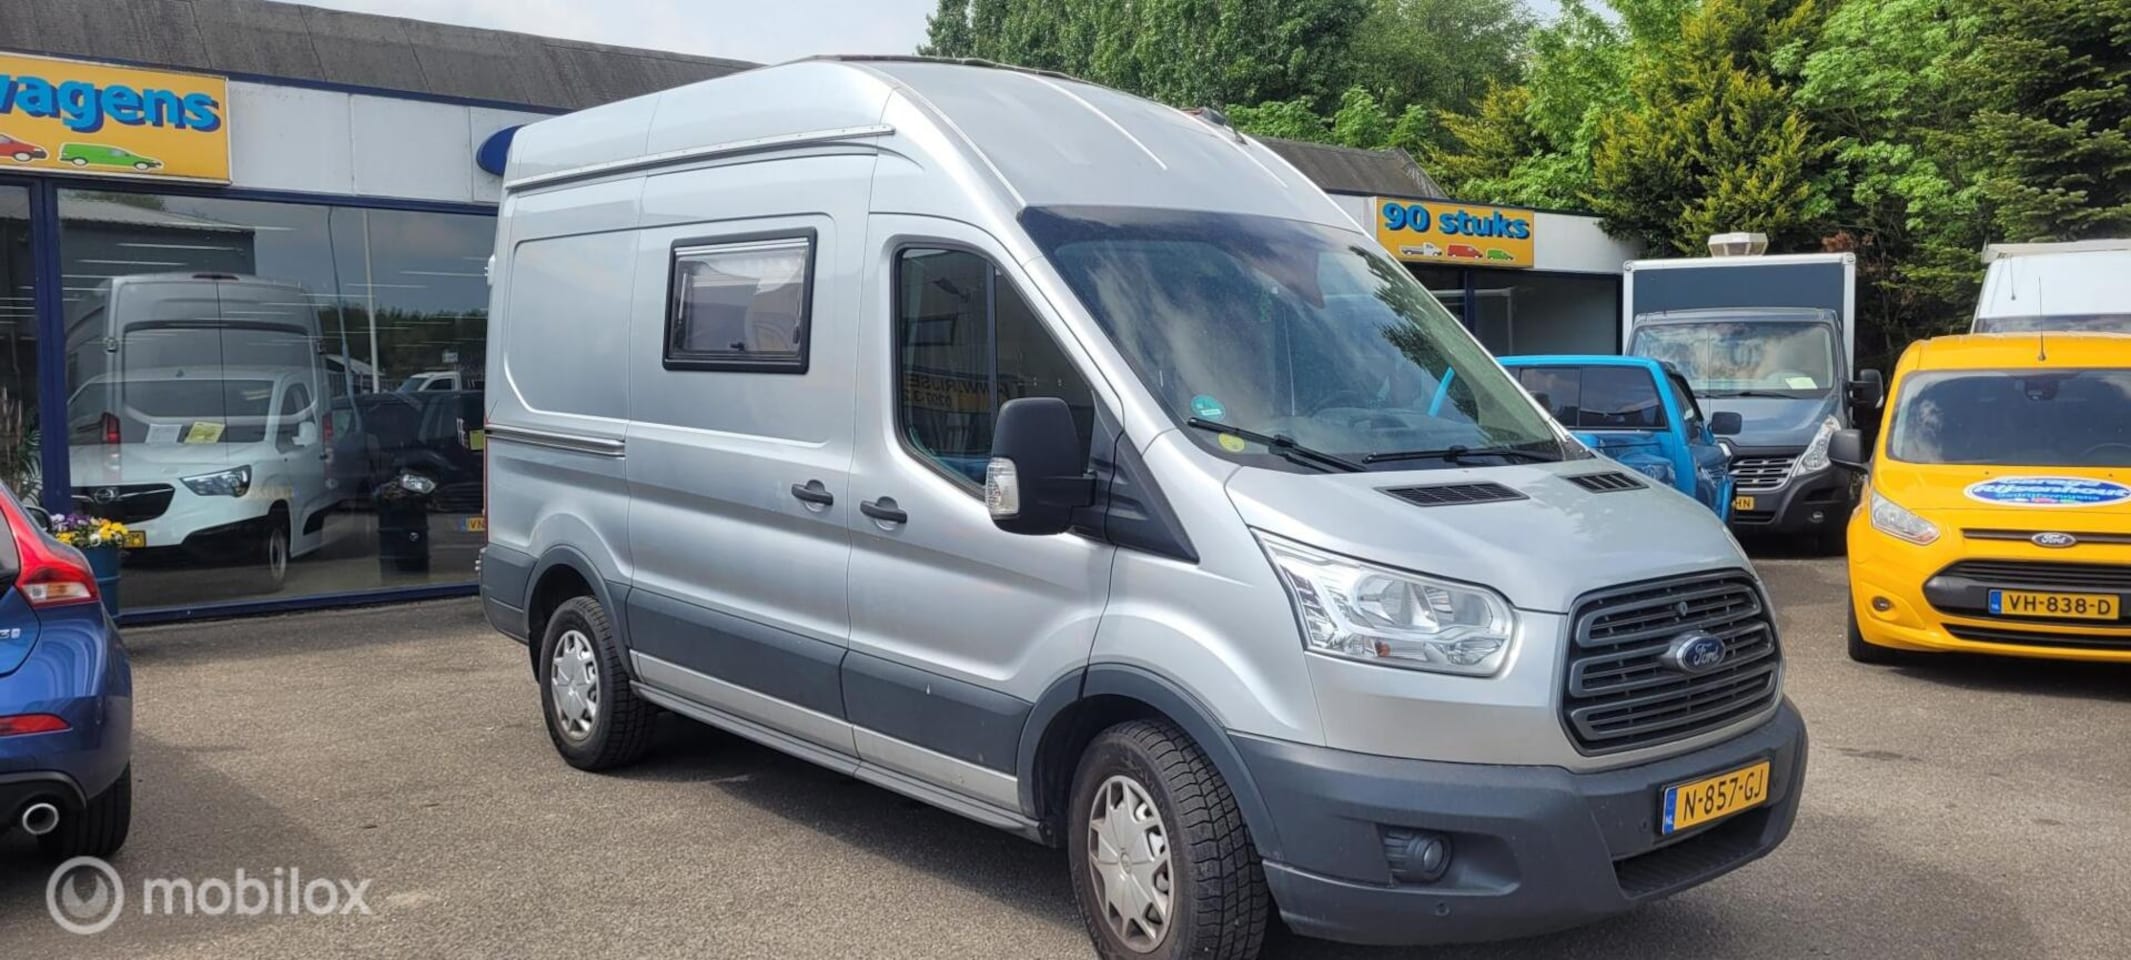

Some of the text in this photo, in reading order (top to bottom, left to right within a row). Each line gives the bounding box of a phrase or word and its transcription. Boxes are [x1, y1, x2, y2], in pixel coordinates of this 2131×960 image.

[1382, 203, 1530, 240] 90 stuks
[2041, 534, 2066, 544] Ford
[2009, 595, 2112, 616] VH-838-D
[1693, 642, 1720, 667] Ford
[1683, 769, 1765, 821] N-857-GJ
